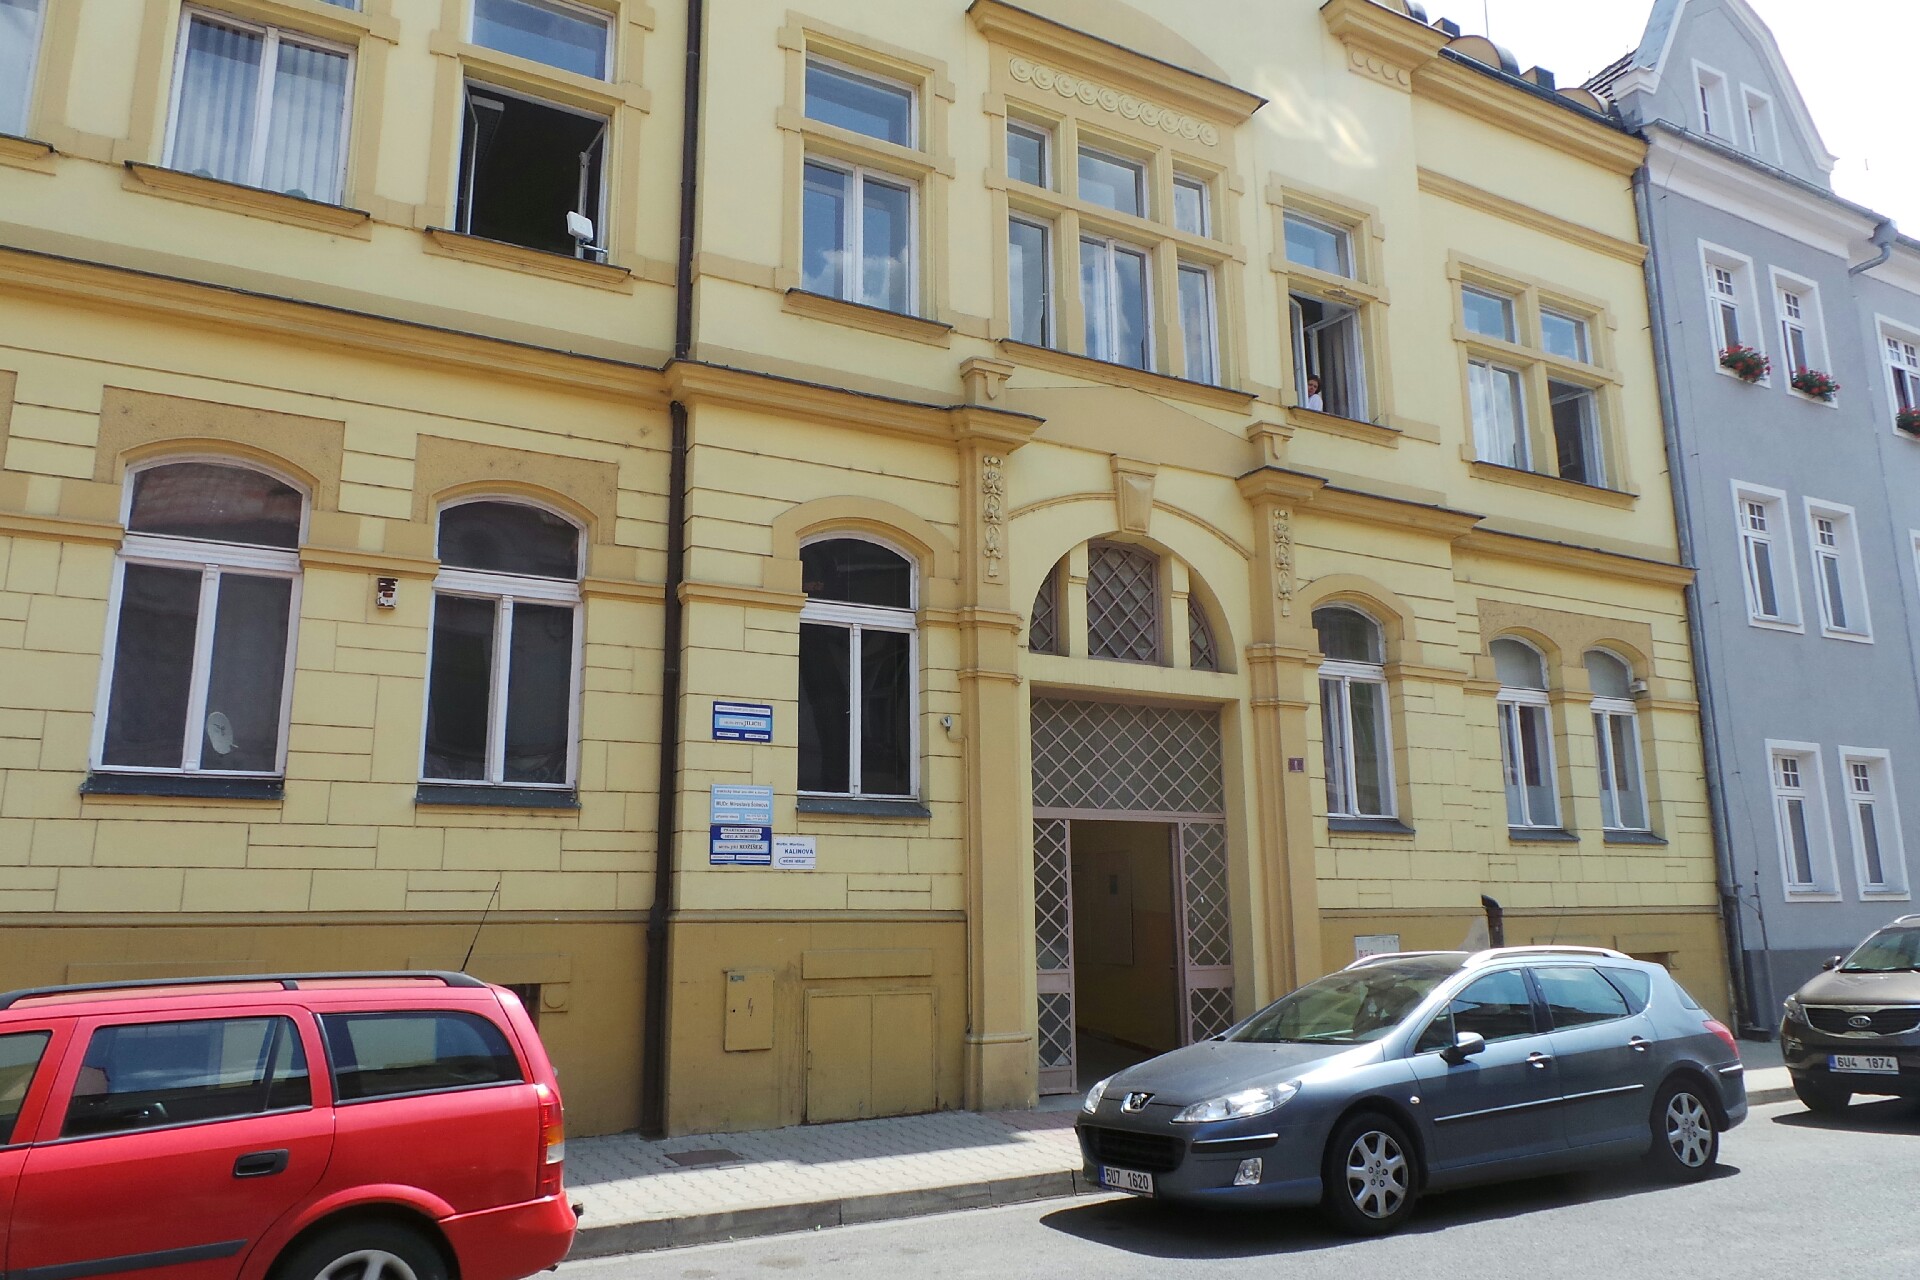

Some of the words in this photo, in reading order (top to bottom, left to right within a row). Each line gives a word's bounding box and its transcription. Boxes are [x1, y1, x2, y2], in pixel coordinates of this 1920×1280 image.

[1837, 1057, 1857, 1068] 6U4
[1866, 1057, 1893, 1069] 1874
[1106, 1168, 1120, 1184] 5U7
[1128, 1172, 1149, 1190] 1620
